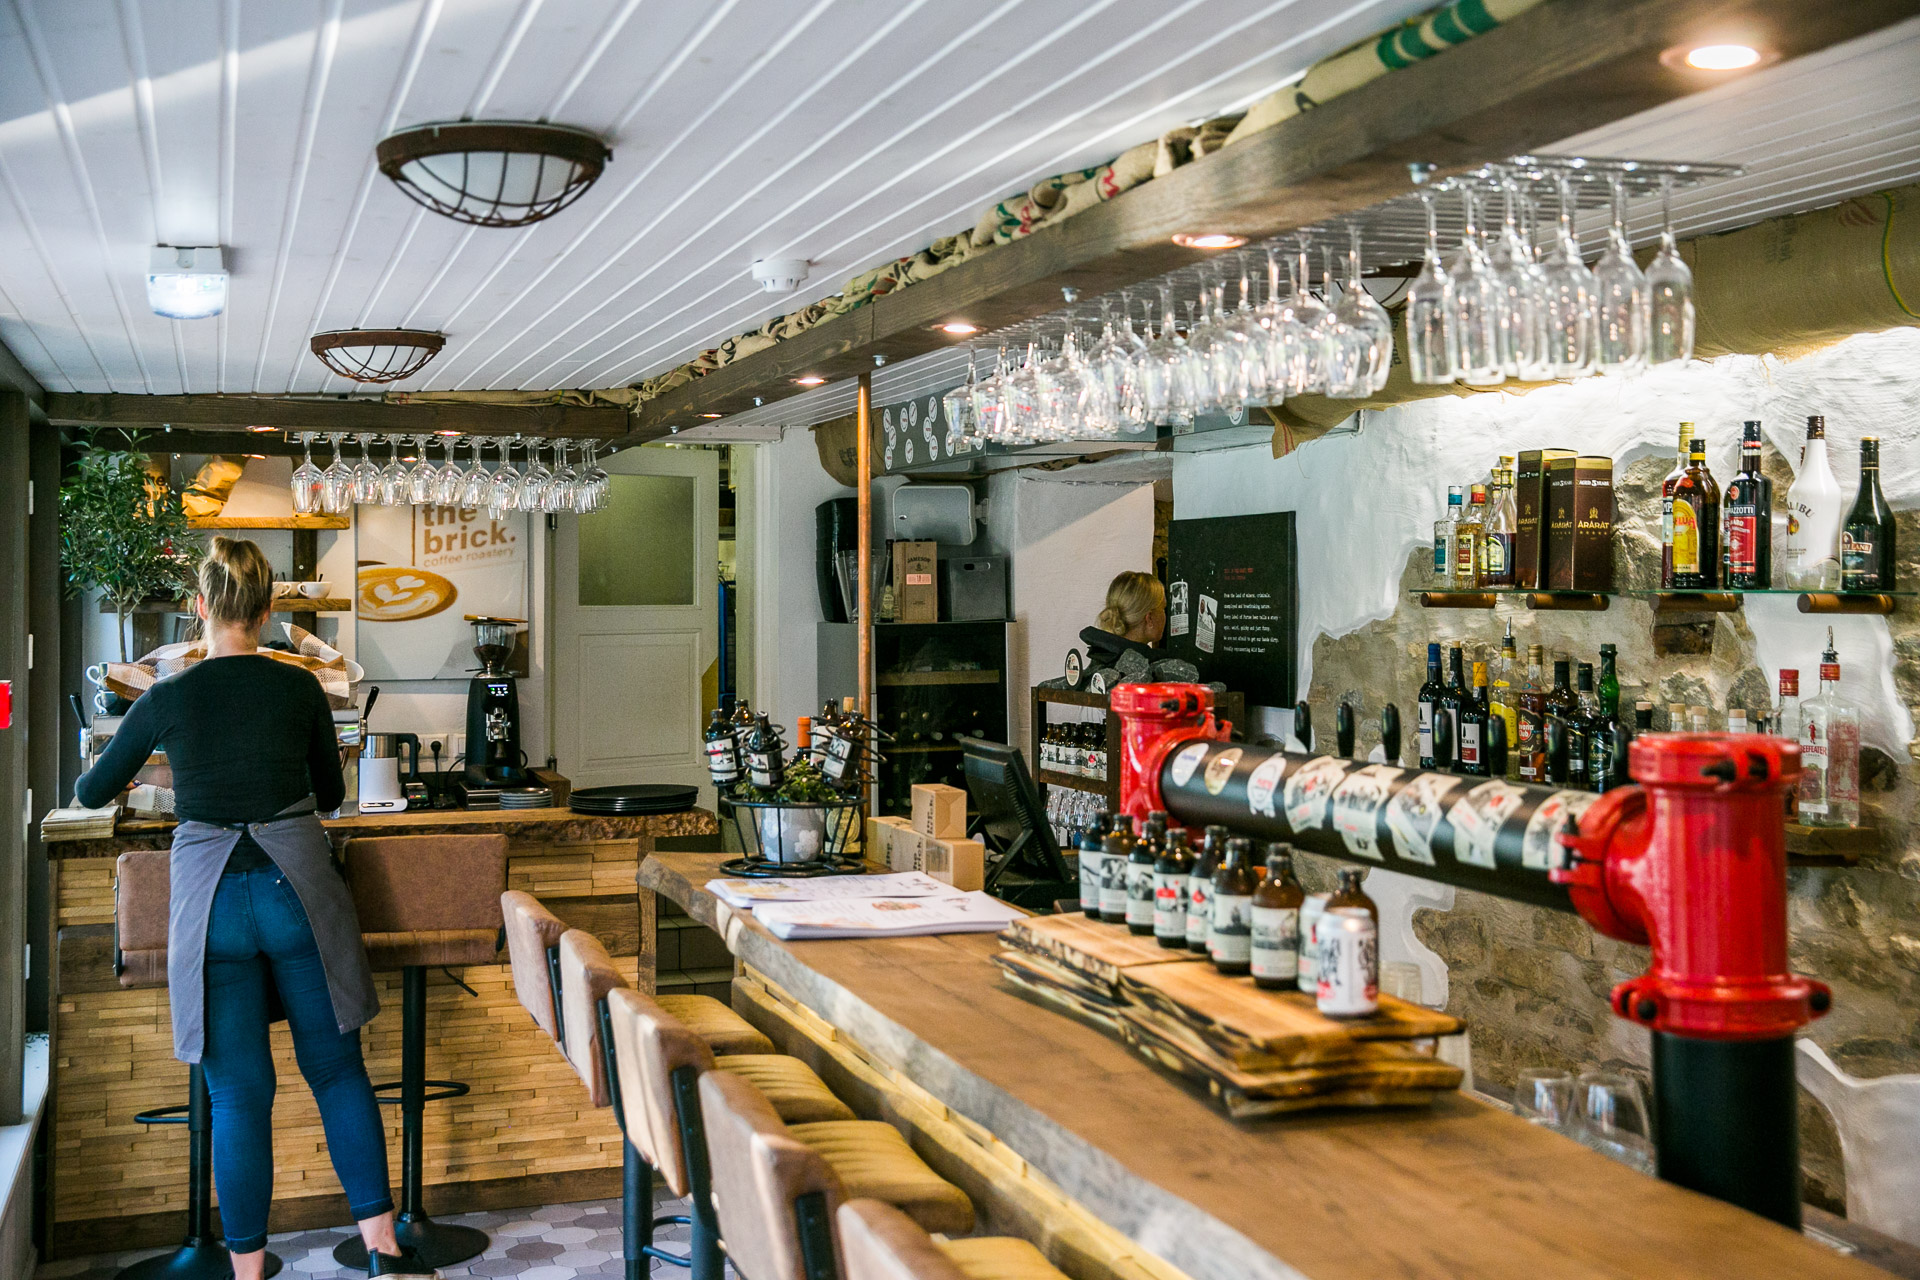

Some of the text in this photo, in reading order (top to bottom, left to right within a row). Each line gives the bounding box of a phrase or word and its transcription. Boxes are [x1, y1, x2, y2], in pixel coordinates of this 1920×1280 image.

[422, 504, 477, 527] the
[1551, 520, 1572, 528] ARARAT
[1577, 520, 1610, 529] ARARAT
[424, 521, 516, 555] brick.
[424, 546, 515, 568] coffee roastery
